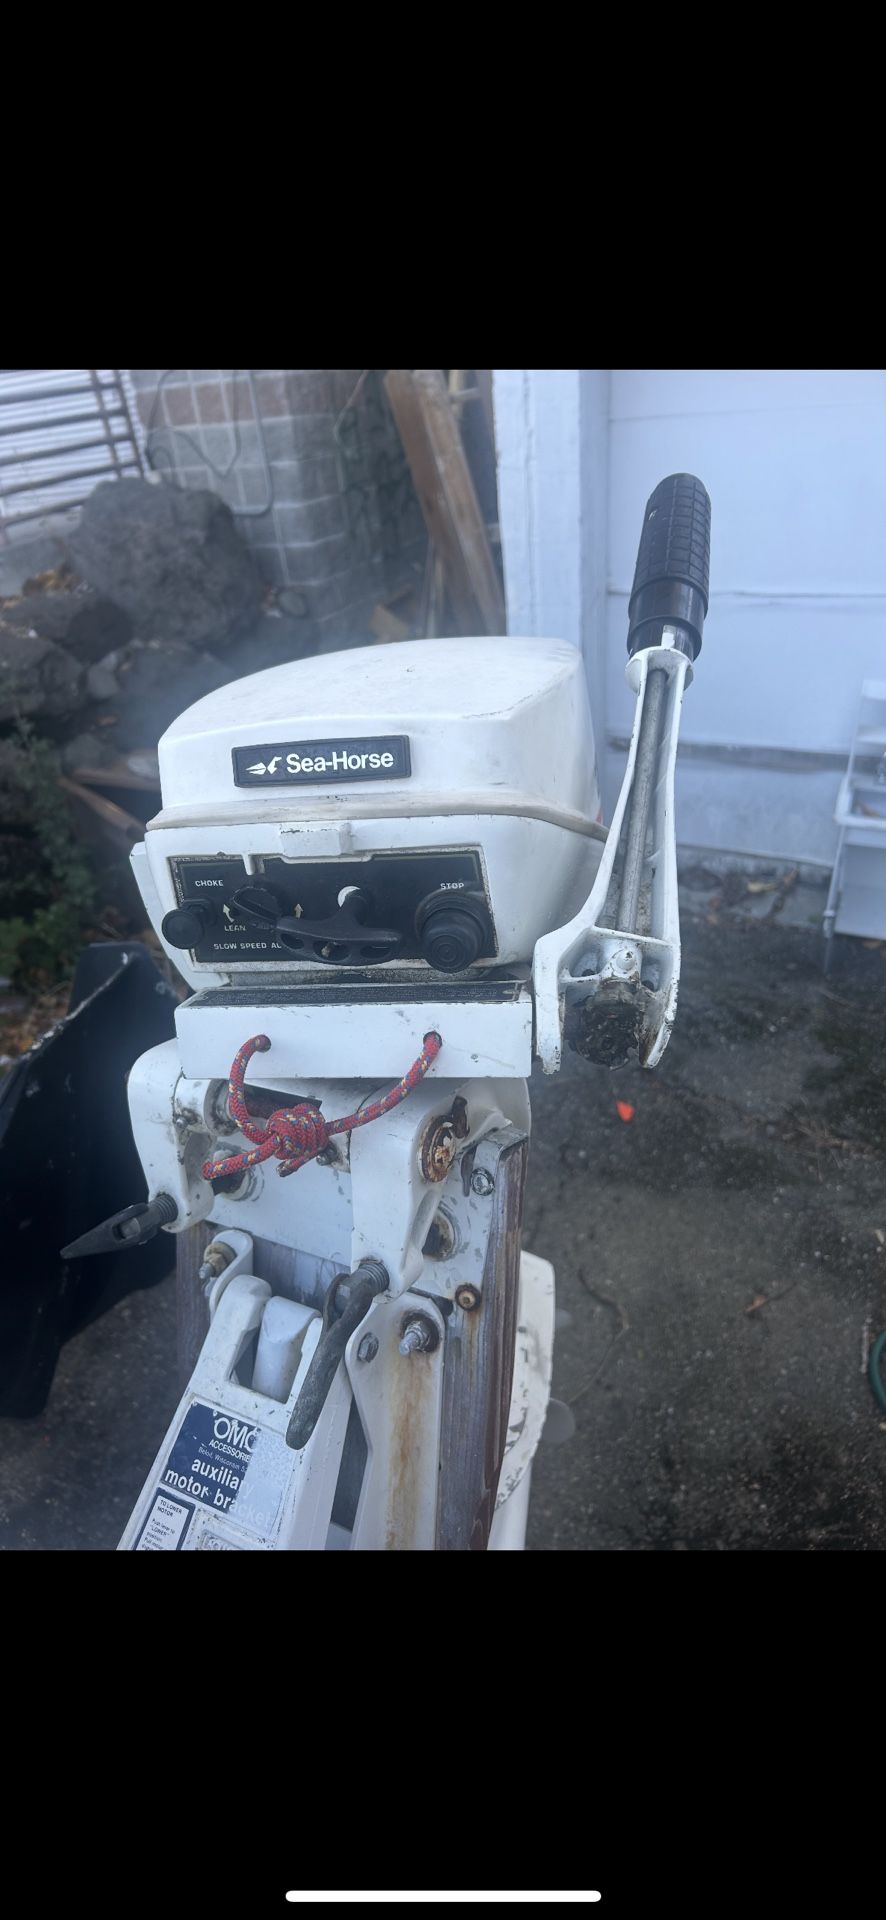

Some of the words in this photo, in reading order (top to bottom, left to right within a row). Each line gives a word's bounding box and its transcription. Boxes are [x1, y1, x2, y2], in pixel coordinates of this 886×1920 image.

[286, 750, 394, 774] Sea-Horse
[194, 879, 224, 887] CHOKE
[439, 882, 465, 890] STOP
[213, 1417, 258, 1453] OMC
[164, 1469, 209, 1498] motor
[157, 1506, 174, 1517] MOTOR
[160, 1499, 167, 1507] TO
[167, 1503, 182, 1514] LOWER
